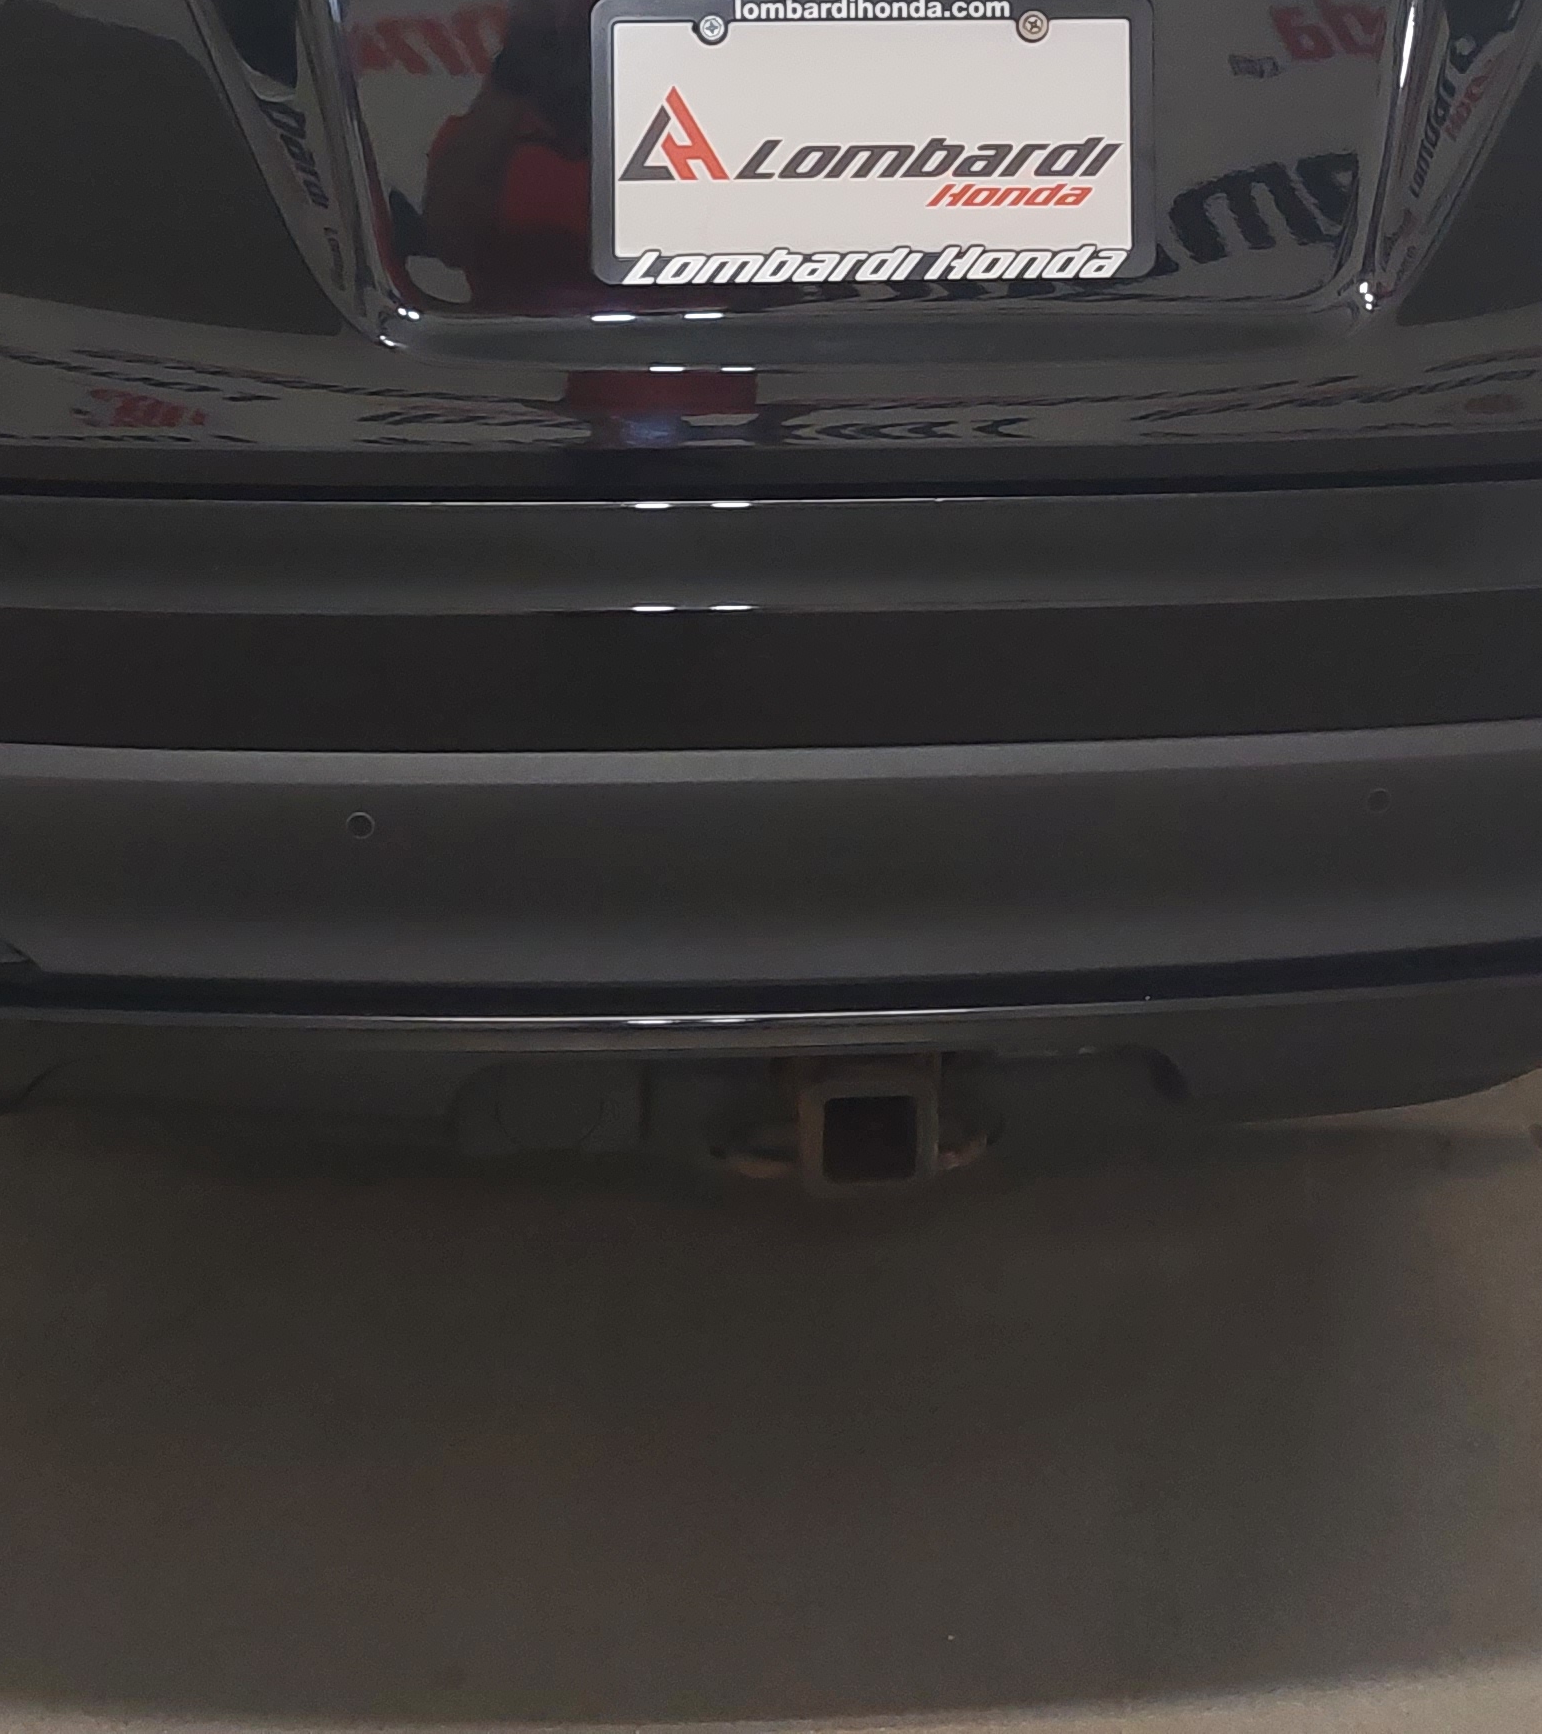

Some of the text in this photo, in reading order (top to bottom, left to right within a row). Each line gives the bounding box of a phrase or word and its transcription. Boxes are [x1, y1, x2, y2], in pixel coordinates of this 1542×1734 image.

[733, 137, 1124, 180] Lombardi
[925, 183, 1094, 208] Honda
[622, 243, 1128, 286] Lombardi Honda
